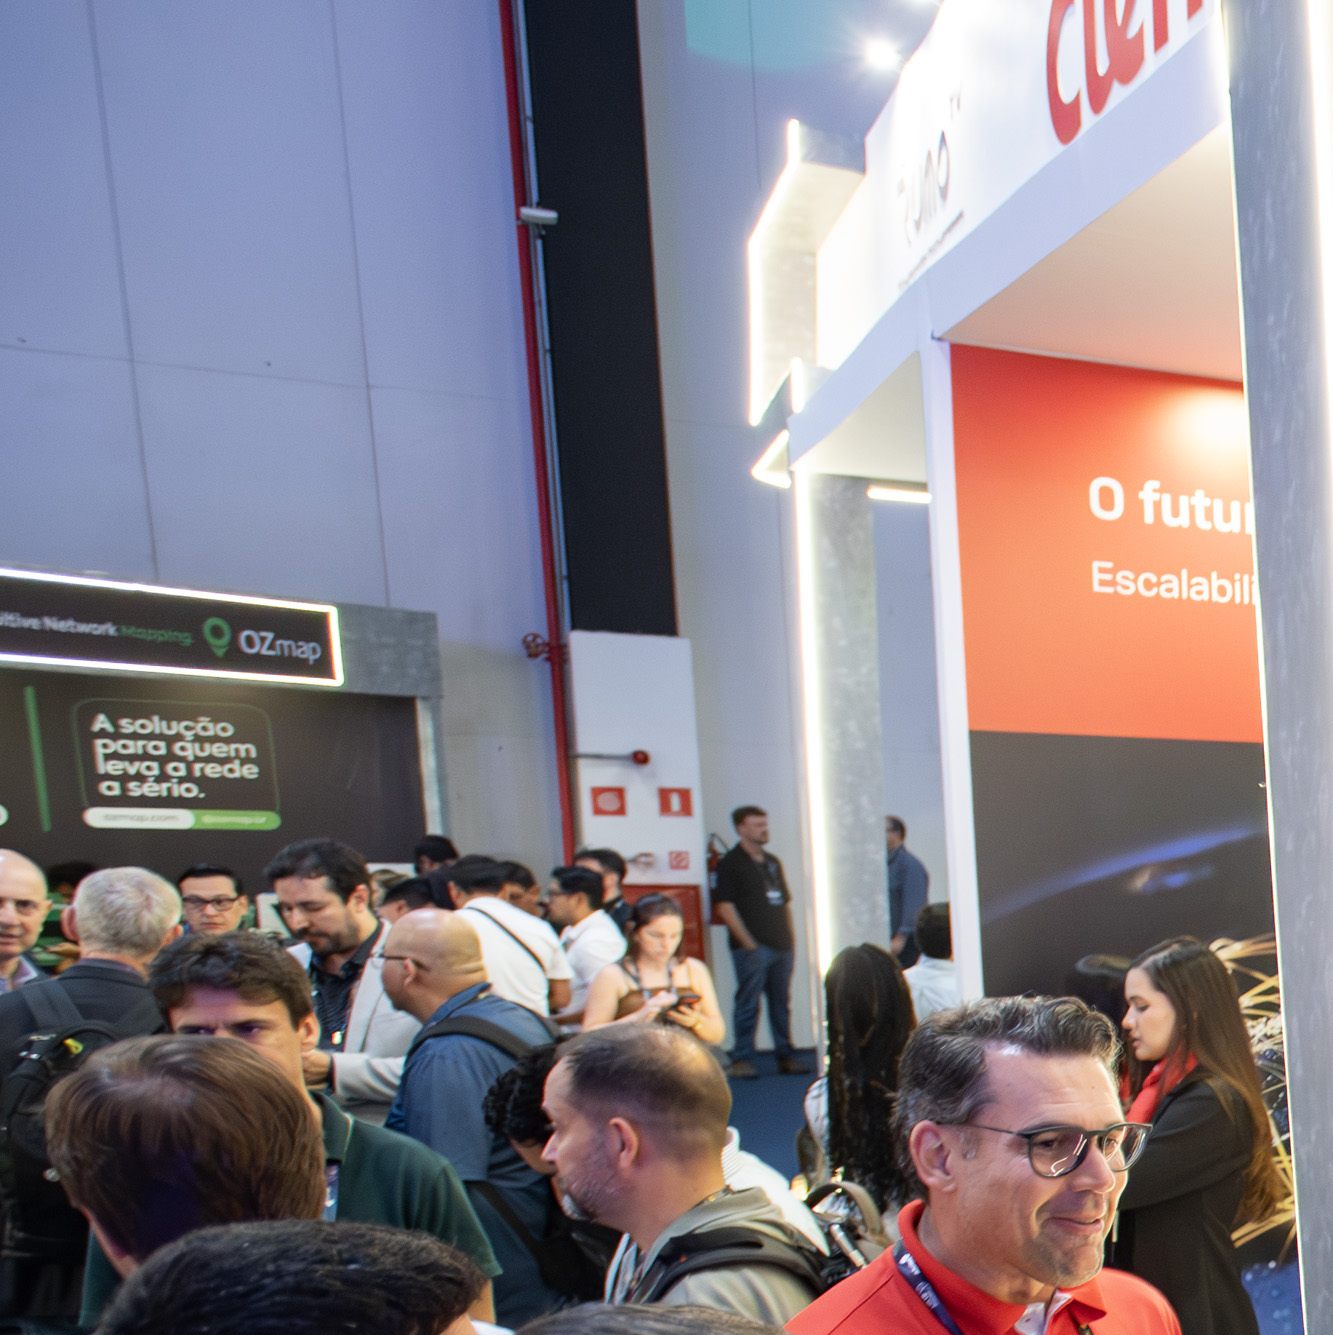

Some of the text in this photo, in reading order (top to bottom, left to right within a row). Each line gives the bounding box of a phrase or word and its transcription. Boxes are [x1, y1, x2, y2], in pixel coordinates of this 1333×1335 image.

[1089, 475, 1125, 521] O
[1138, 480, 1255, 535] futur
[43, 616, 118, 637] Network
[239, 629, 322, 664] OZmap
[91, 713, 235, 741] A solução
[93, 738, 257, 761] para quem
[96, 755, 259, 779] leva a rede
[98, 777, 206, 799] a sério.
